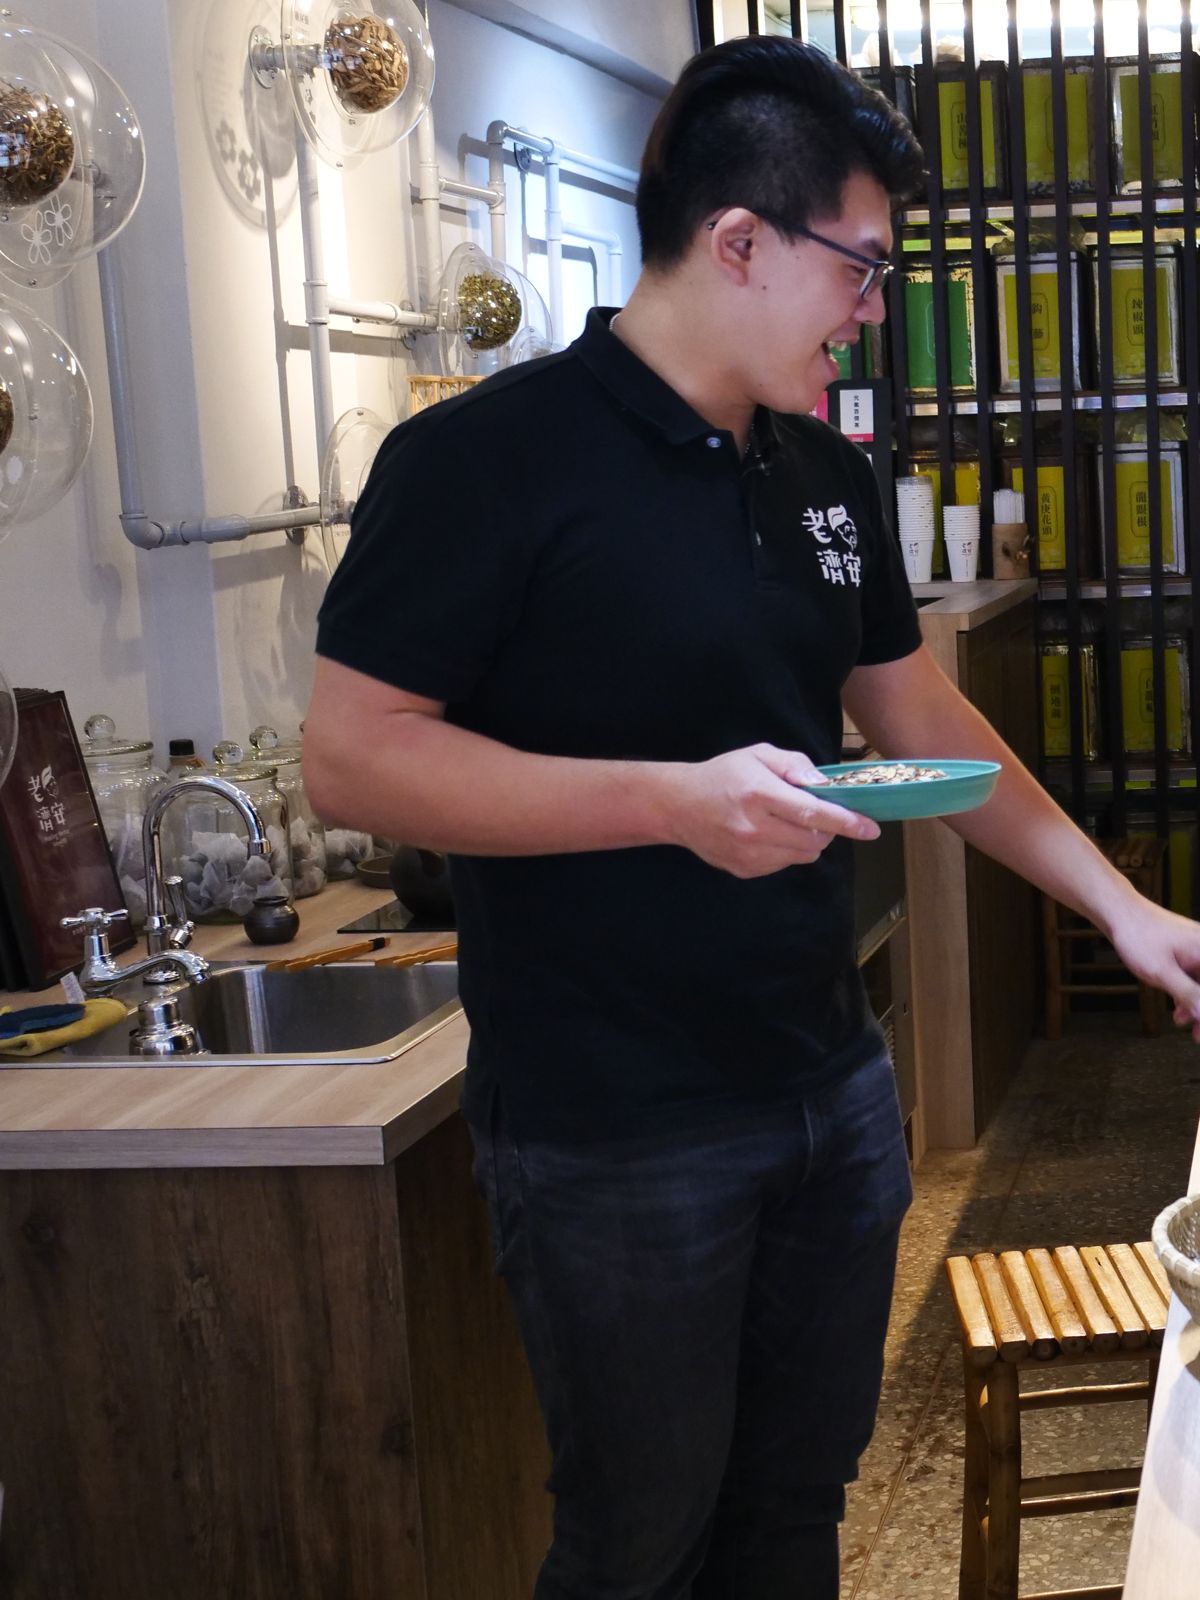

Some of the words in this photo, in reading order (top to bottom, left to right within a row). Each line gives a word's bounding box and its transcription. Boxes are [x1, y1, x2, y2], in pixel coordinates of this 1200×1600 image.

[801, 507, 832, 544] 老
[816, 548, 862, 588] 濟安
[27, 775, 44, 803] 老
